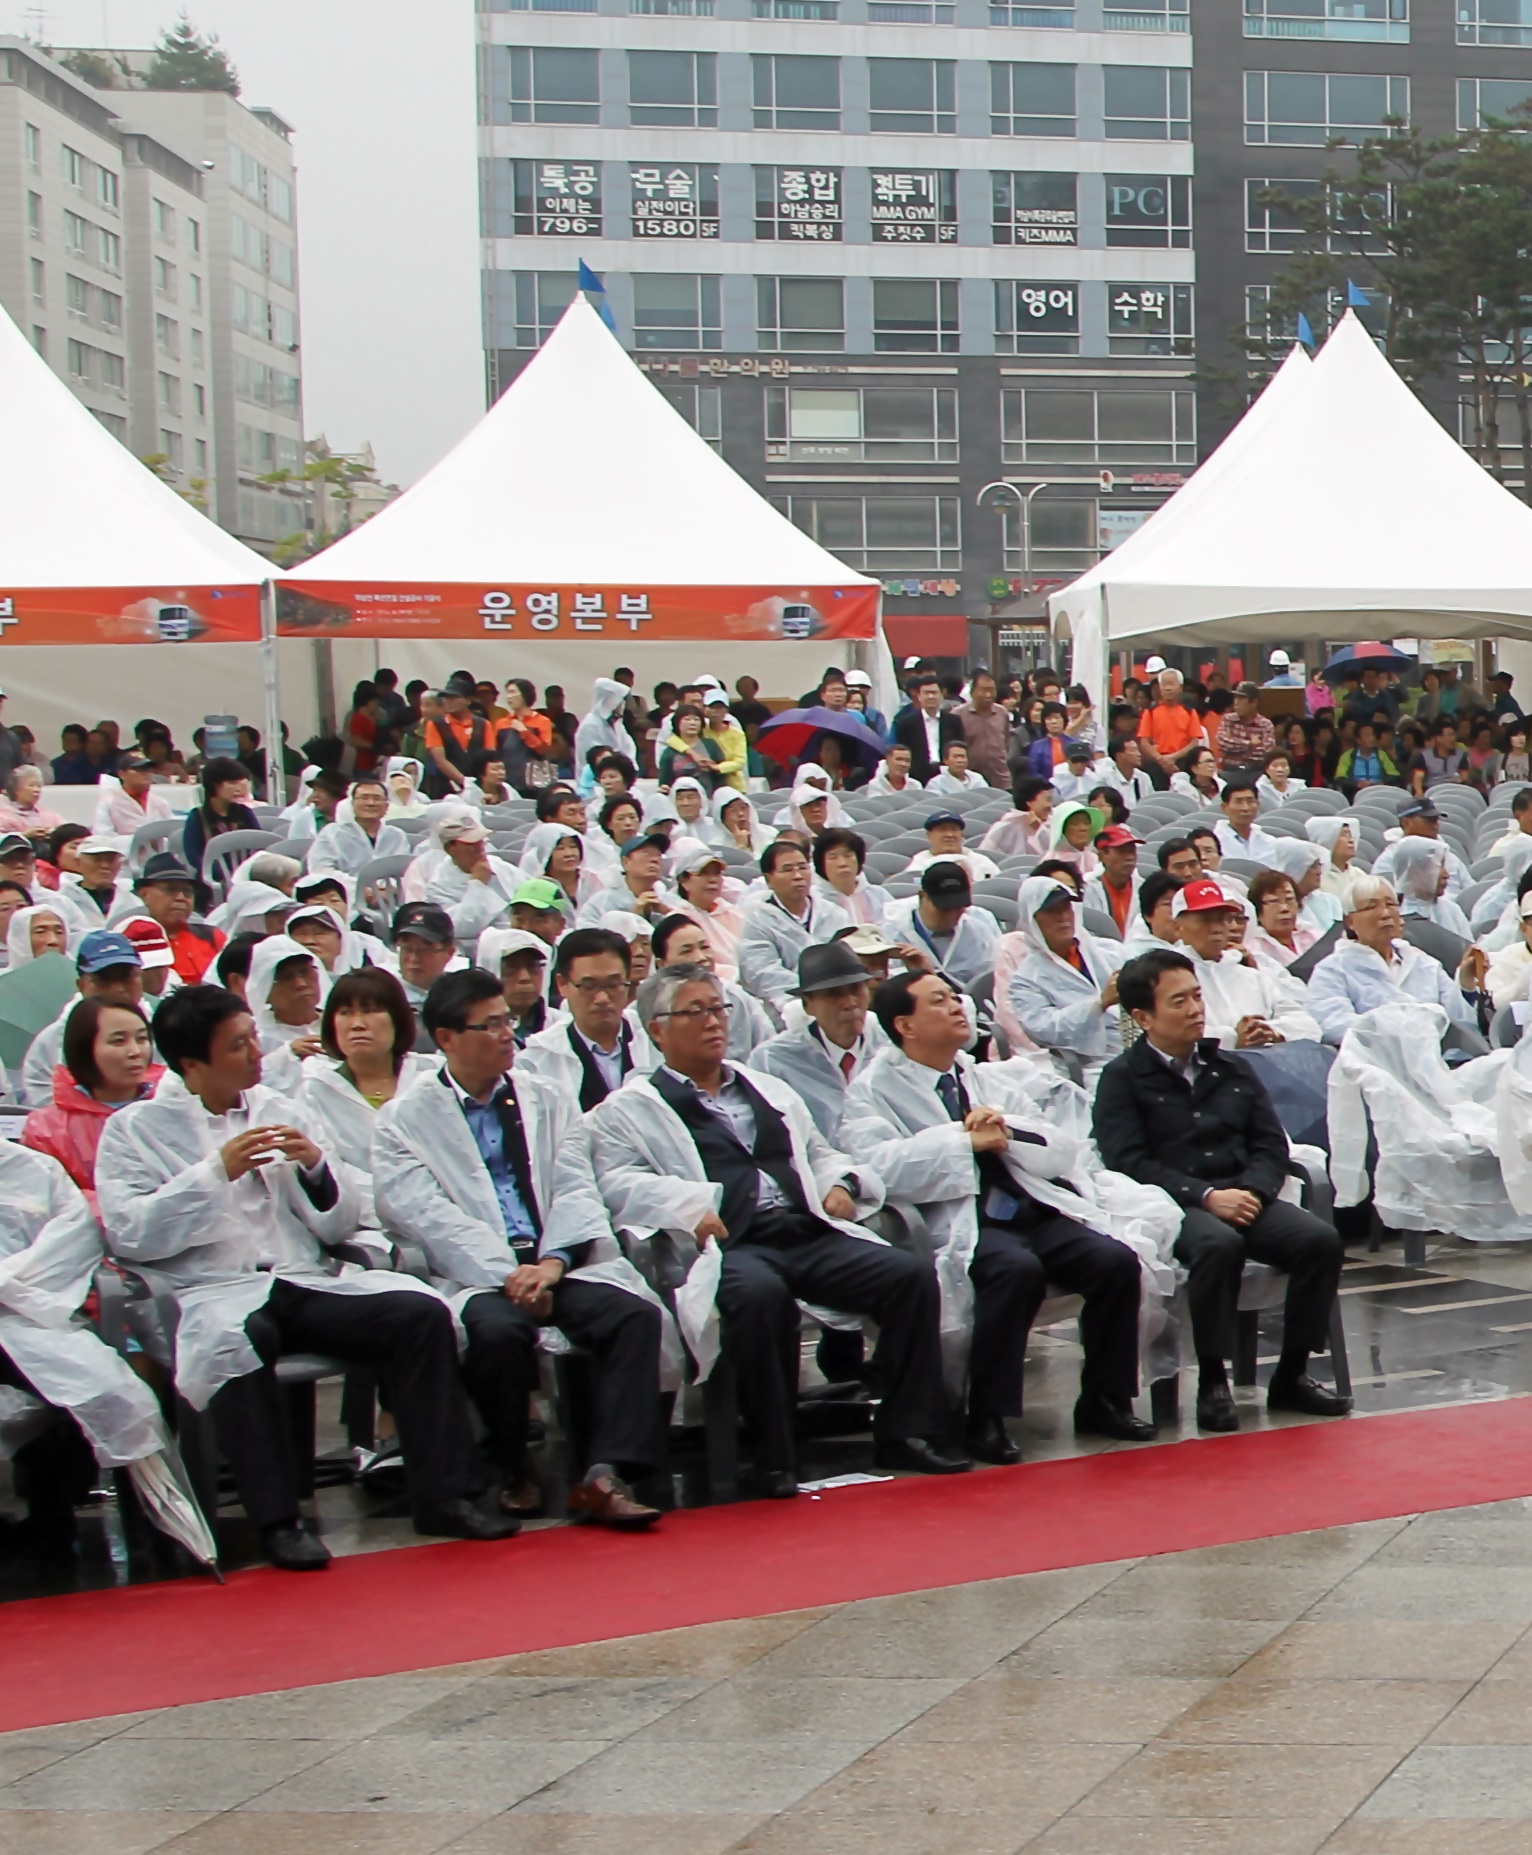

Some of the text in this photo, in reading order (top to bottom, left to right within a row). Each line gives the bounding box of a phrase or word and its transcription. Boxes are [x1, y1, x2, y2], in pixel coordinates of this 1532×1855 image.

[540, 165, 693, 198] 특공 무술
[781, 171, 838, 201] 종합
[545, 198, 695, 216] 이제는 실전이다
[780, 203, 935, 219] 하남승리 MMA GYM
[1110, 186, 1165, 216] PC
[540, 217, 718, 236] 796- 1580 5F
[881, 226, 926, 240] 주짓수
[940, 227, 956, 240] 5F
[1022, 289, 1165, 319] 영어 수학
[478, 592, 653, 631] 운영본부
